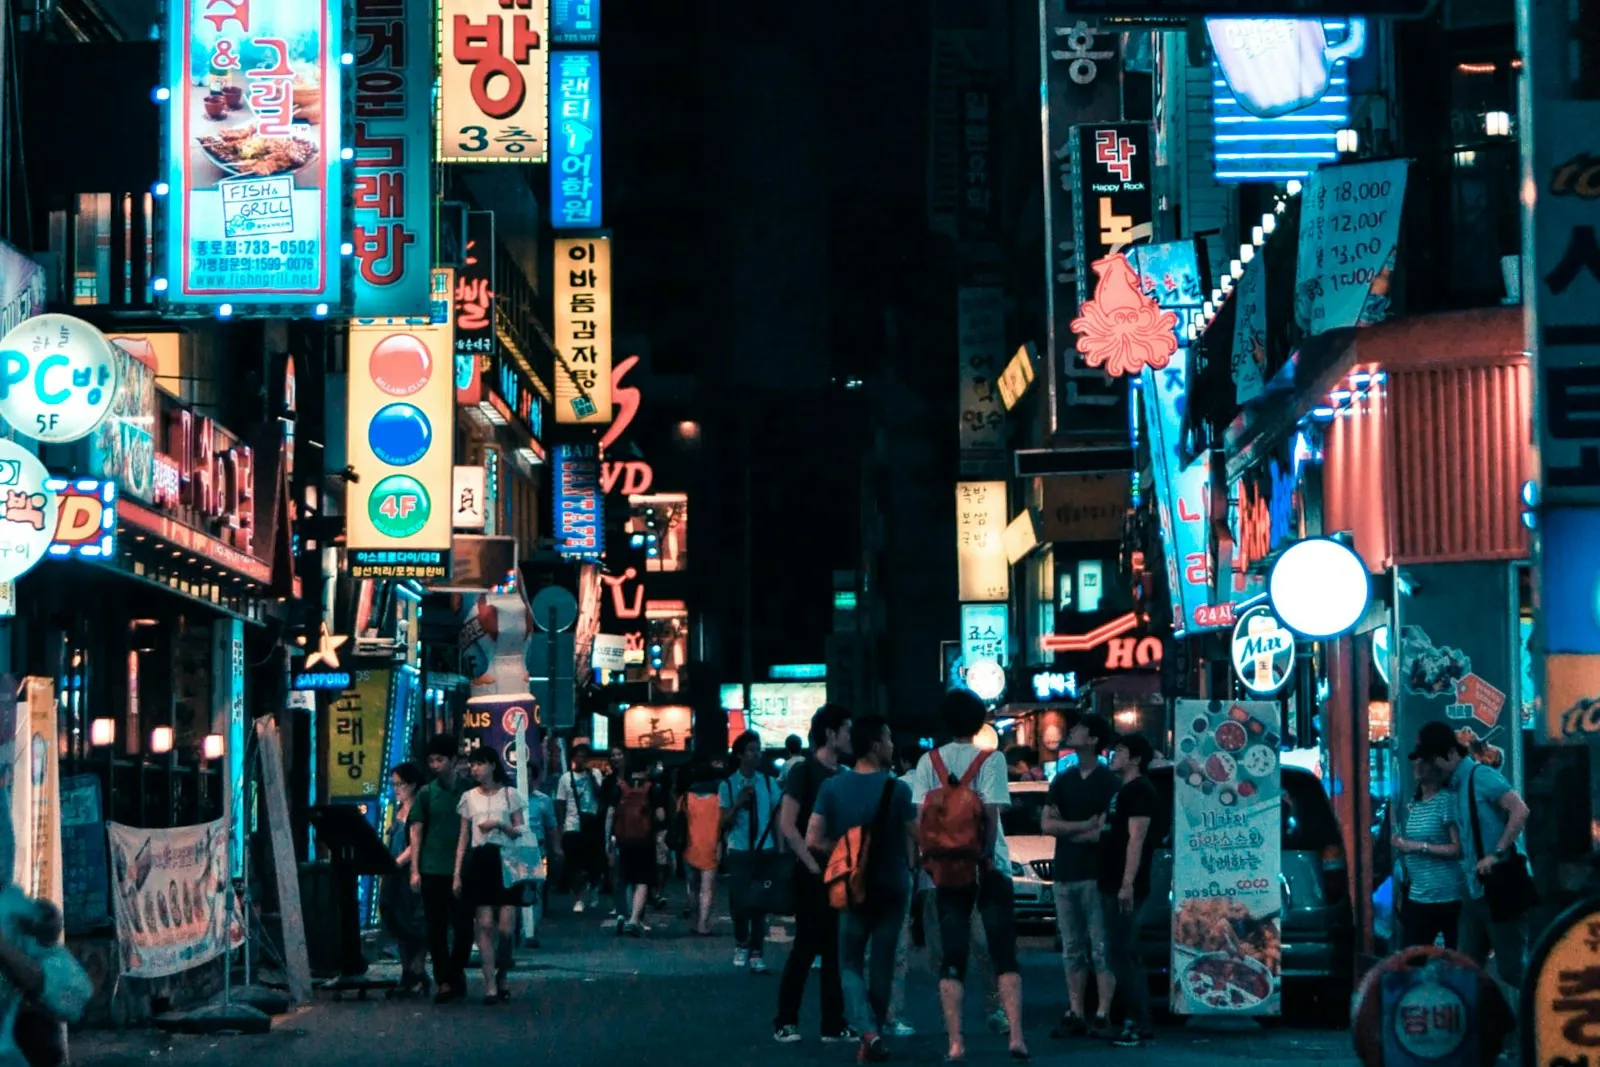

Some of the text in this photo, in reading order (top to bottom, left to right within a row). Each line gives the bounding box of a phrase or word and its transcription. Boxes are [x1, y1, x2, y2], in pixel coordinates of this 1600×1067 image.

[453, 0, 540, 120] 방
[247, 39, 294, 137] 그릴
[458, 125, 538, 153] 3층
[1096, 130, 1136, 181] 락
[230, 184, 270, 198] FISH
[1092, 182, 1146, 192] Happy Rock
[1333, 180, 1392, 204] 18,000
[240, 201, 289, 217] GRILL
[0, 350, 110, 406] PC방
[36, 413, 60, 434] 5F
[562, 444, 594, 458] BAR
[55, 494, 103, 542] D
[379, 495, 418, 519] 4F
[1241, 634, 1284, 664] Max
[297, 672, 350, 686] SAPPORO
